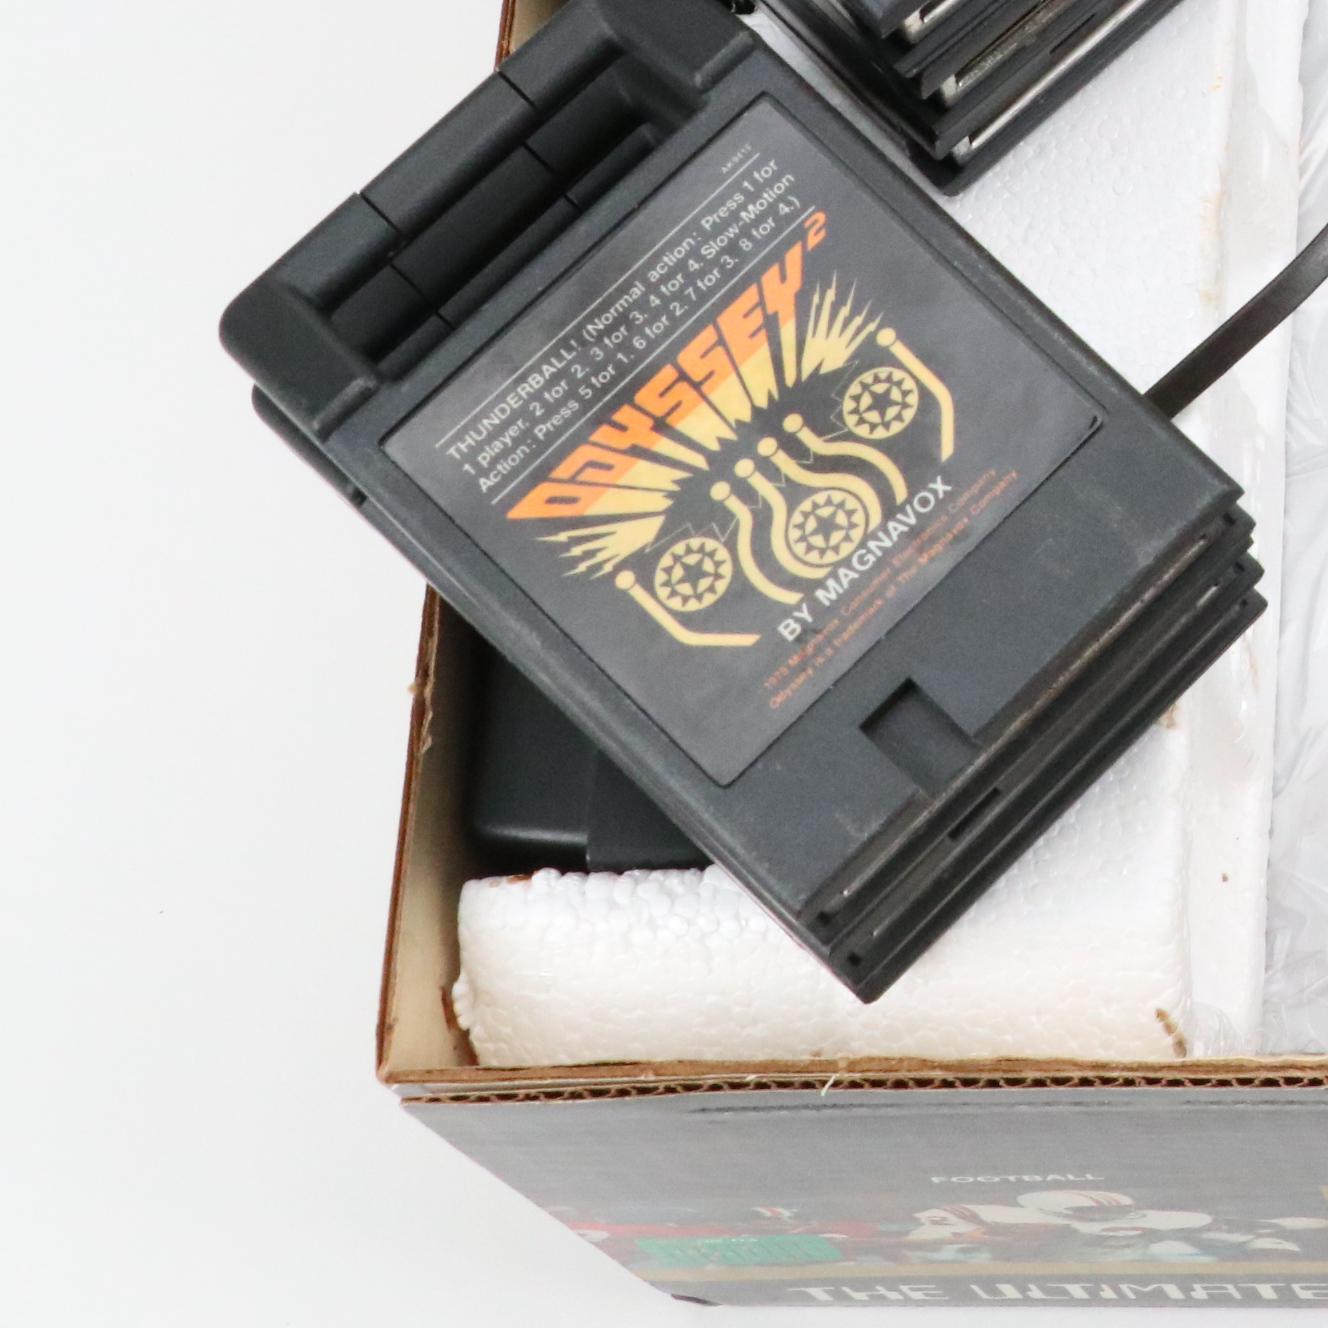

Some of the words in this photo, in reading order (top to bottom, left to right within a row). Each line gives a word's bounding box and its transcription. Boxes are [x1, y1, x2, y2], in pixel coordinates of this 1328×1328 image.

[446, 340, 575, 459] THUNDERBALL!
[582, 280, 645, 341] (Normal
[648, 232, 701, 281] action:
[700, 192, 744, 230] Press
[743, 180, 754, 191] 1
[753, 159, 777, 182] for
[463, 463, 475, 474] 1
[529, 402, 544, 416] 2
[543, 379, 567, 402] for
[590, 347, 603, 360] 3
[603, 325, 628, 348] for
[649, 294, 660, 306] 4
[660, 273, 684, 295] for
[700, 174, 794, 258] Slow-Motion
[478, 445, 535, 492] Action:
[533, 400, 578, 440] Press
[578, 385, 592, 399] 5
[590, 364, 615, 387] for
[632, 336, 646, 349] 6
[644, 314, 669, 338] for
[684, 286, 696, 300] 7
[696, 268, 720, 290] for
[739, 238, 752, 251] 8
[751, 216, 774, 238] for
[777, 602, 812, 641] BY
[815, 475, 952, 605] MAGNAVOX
[931, 1173, 1105, 1184] FOOTBALL
[788, 1283, 950, 1303] THE
